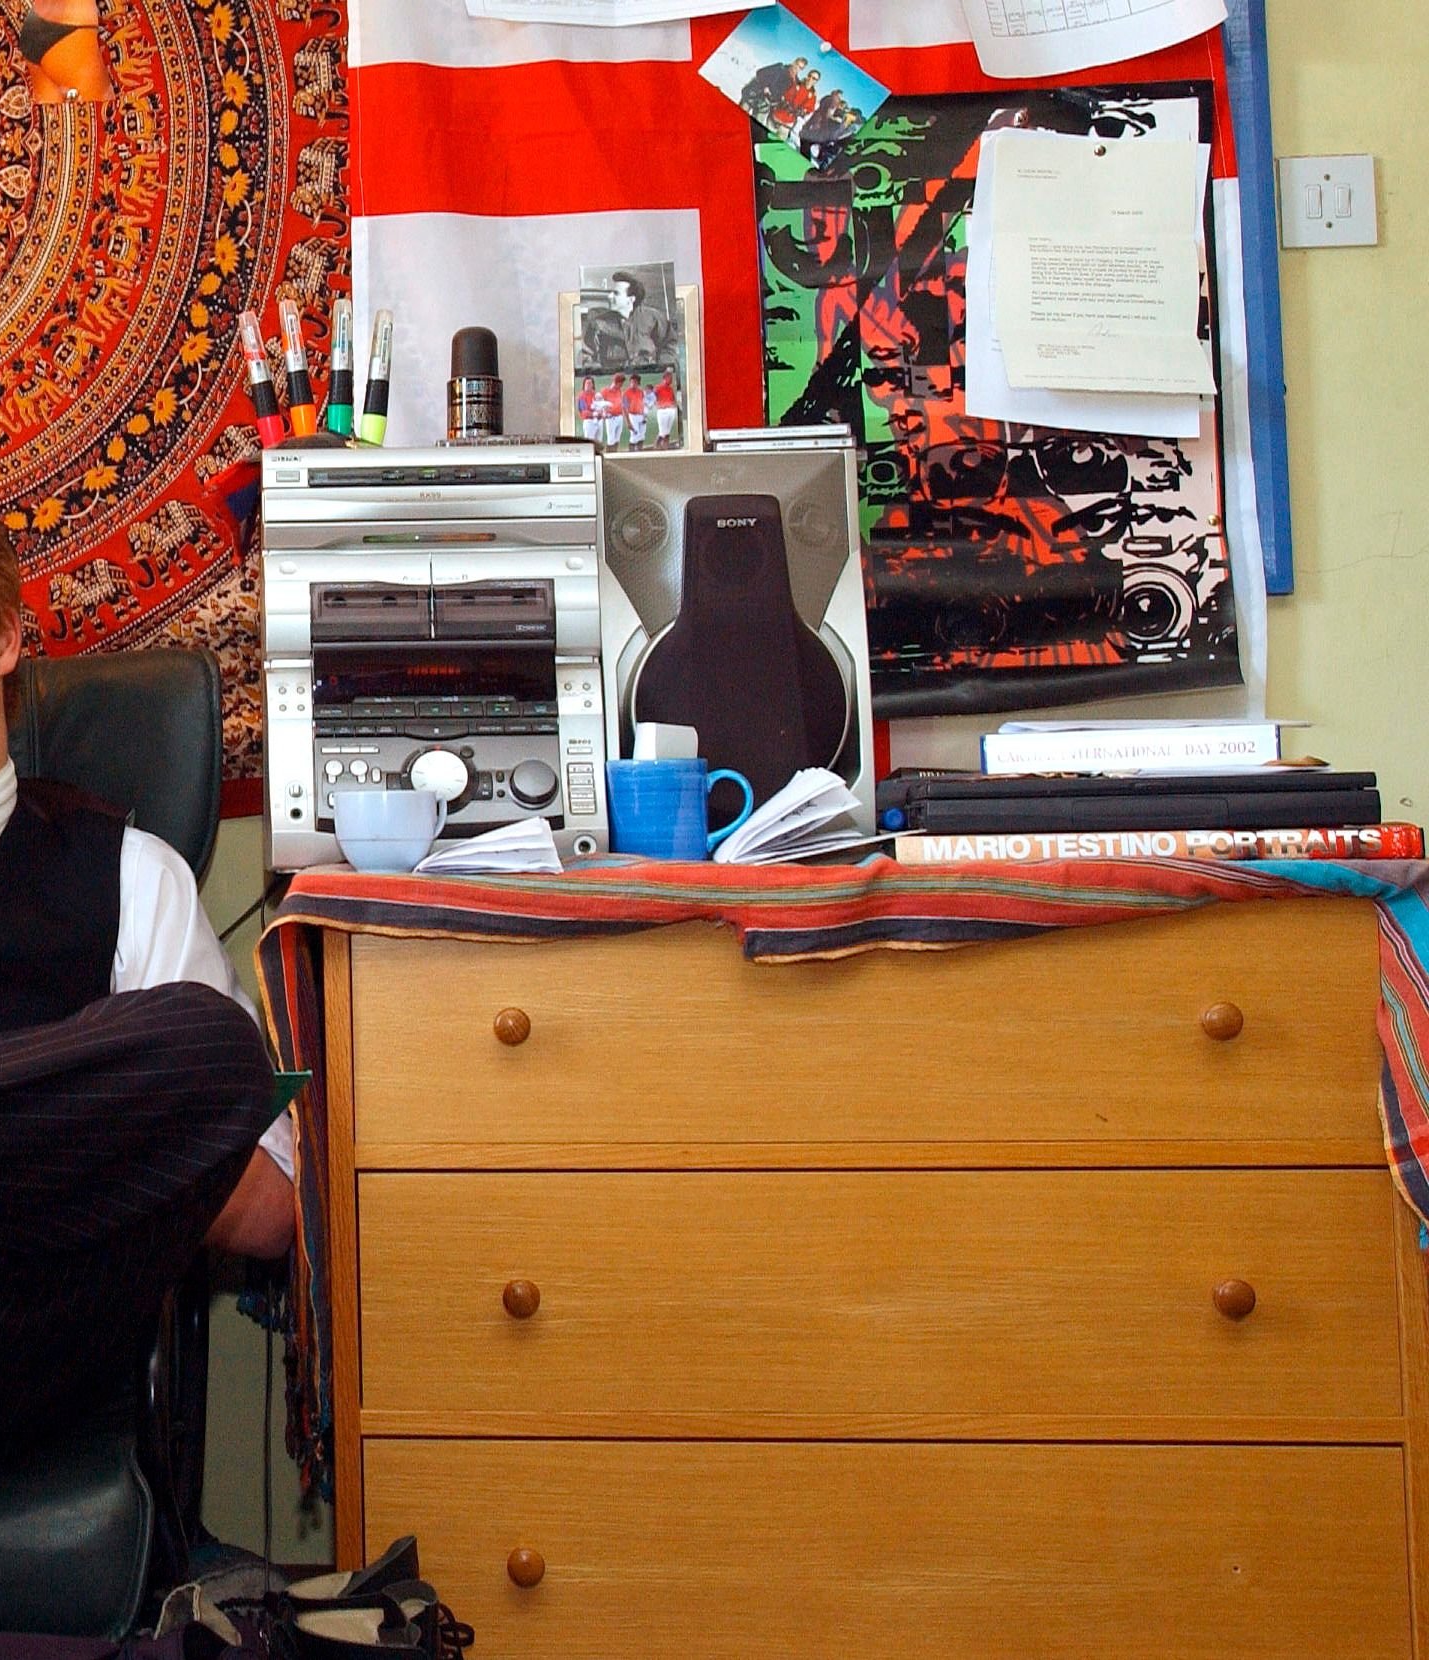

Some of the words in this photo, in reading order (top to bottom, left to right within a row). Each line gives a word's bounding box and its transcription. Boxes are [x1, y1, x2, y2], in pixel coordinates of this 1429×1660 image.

[716, 518, 757, 528] SONY
[1184, 743, 1213, 756] DAY
[1218, 741, 1256, 755] 2002
[923, 834, 1031, 860] MARIO
[1033, 831, 1177, 858] TESTINO
[1186, 828, 1382, 856] PORTRAITS
